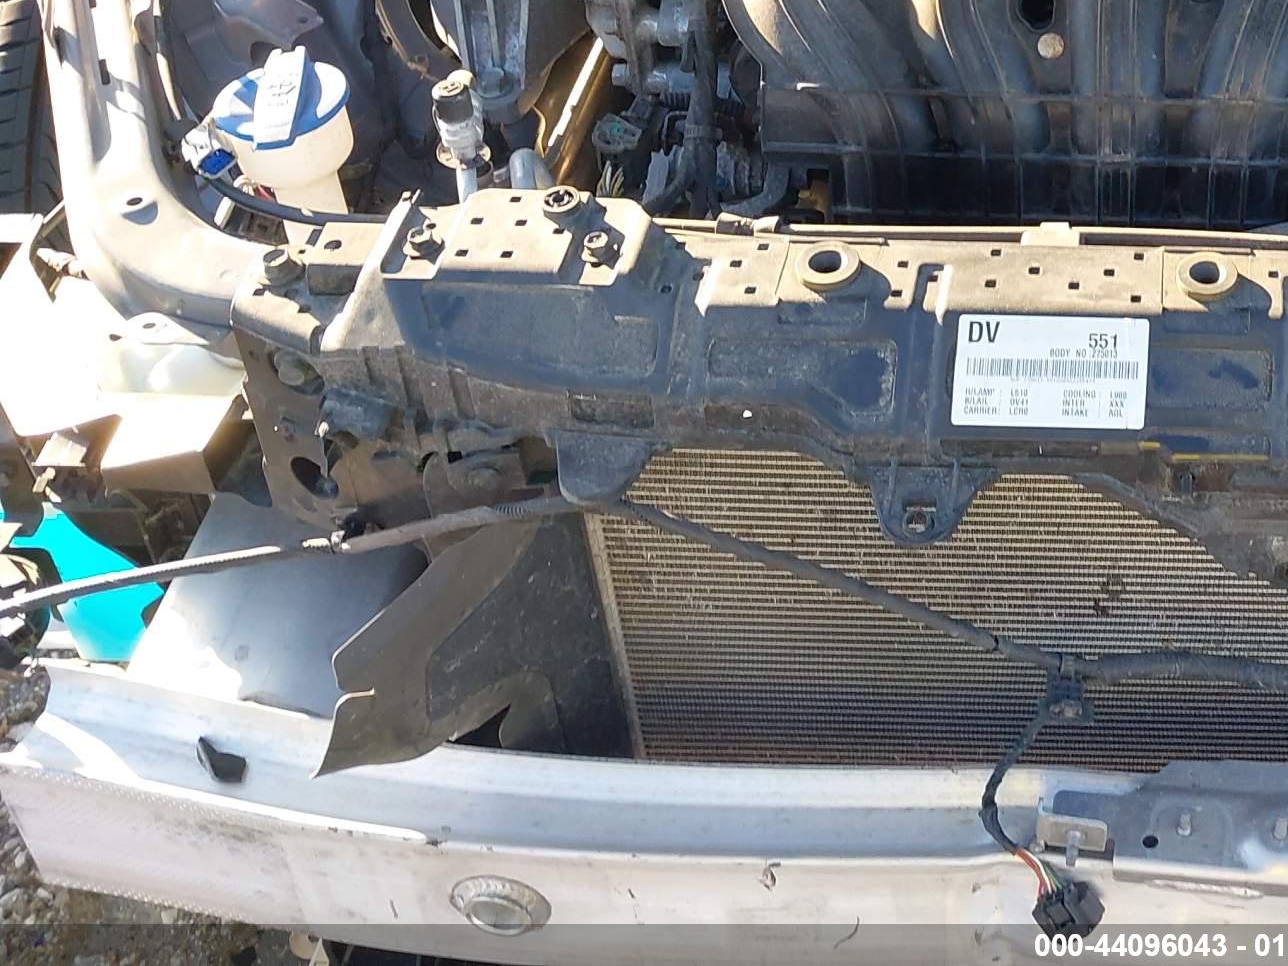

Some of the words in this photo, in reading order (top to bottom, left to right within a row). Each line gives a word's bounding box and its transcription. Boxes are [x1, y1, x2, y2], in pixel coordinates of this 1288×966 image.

[968, 321, 1000, 343] DV
[1088, 333, 1118, 349] 551
[1049, 348, 1070, 358] BODY
